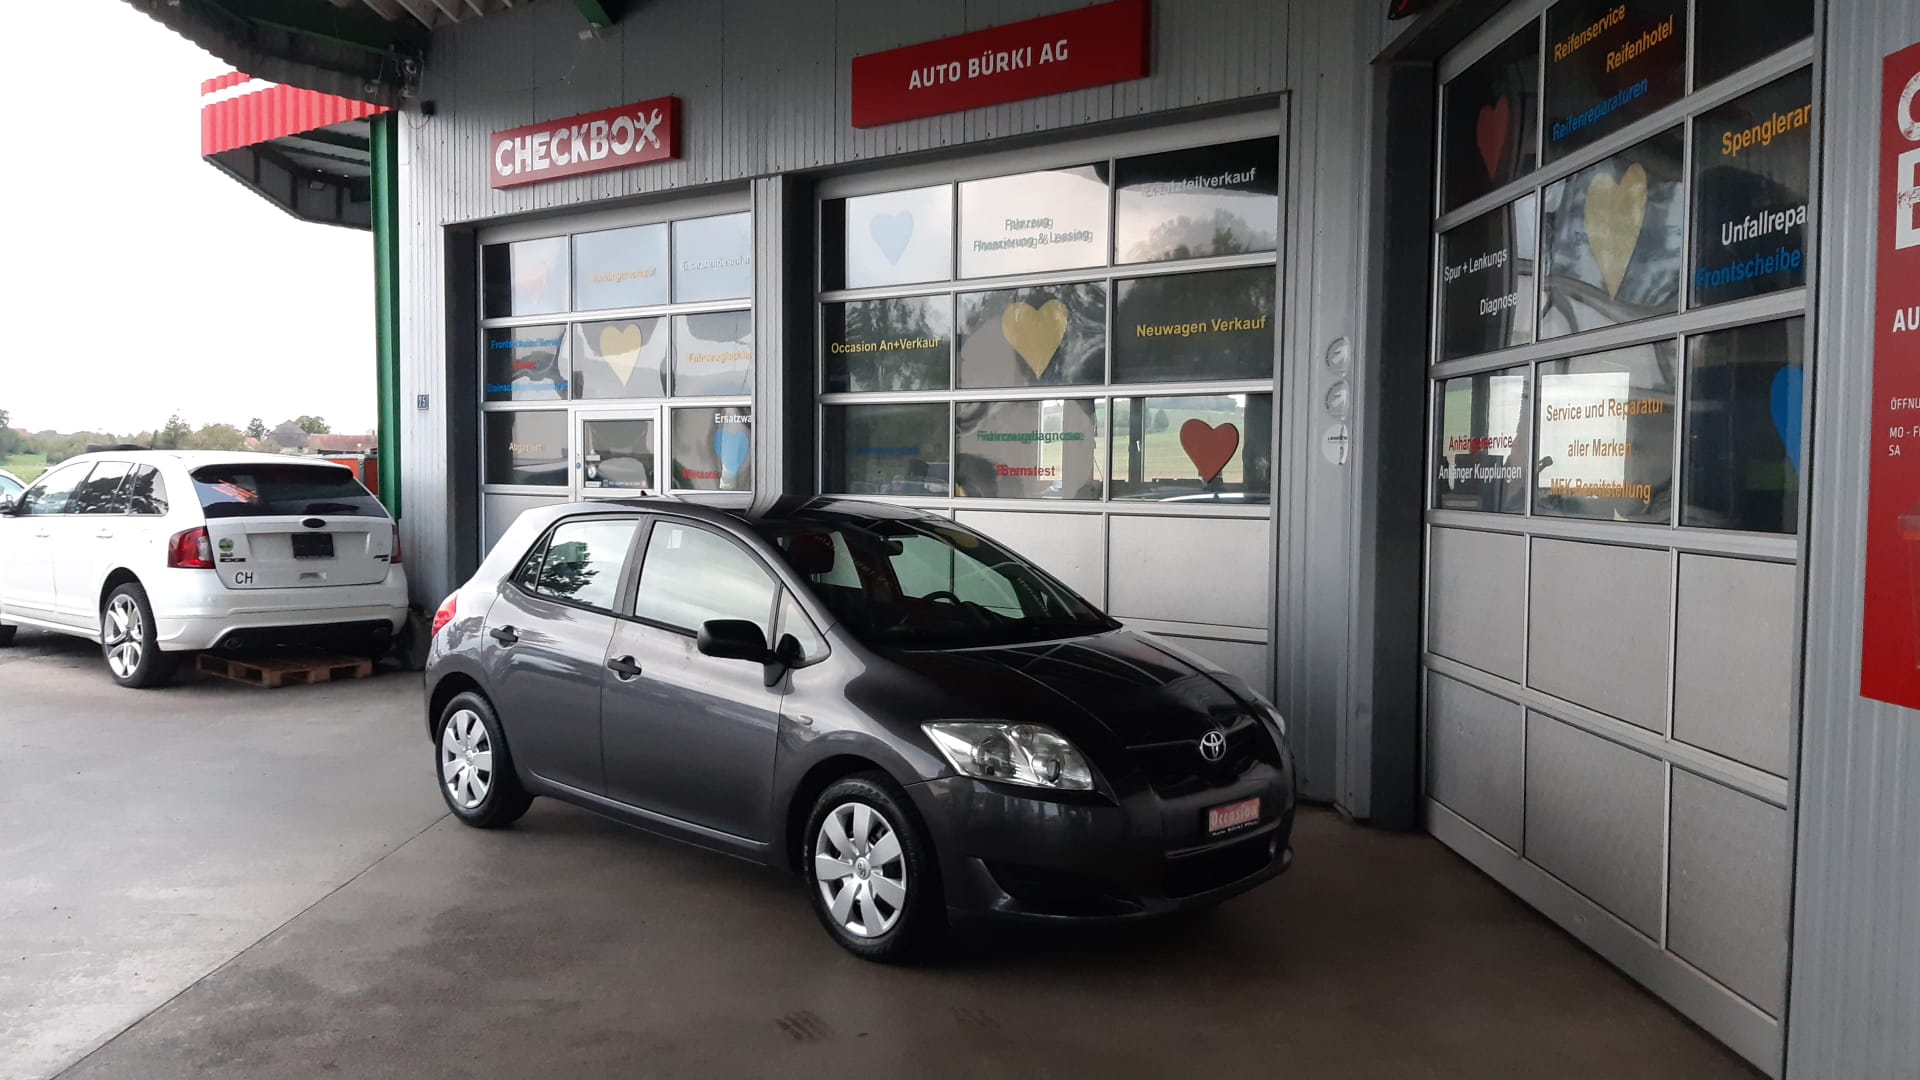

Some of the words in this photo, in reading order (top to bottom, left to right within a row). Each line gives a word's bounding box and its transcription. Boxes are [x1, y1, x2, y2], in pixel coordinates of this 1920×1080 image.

[1554, 4, 1626, 62] Reifenservice
[1606, 14, 1673, 72] Reifenhotel
[908, 62, 961, 90] AUTO
[968, 46, 1032, 78] BÜRKI
[1039, 39, 1069, 65] AG
[1552, 78, 1649, 142] Reifenreparaturen
[495, 108, 662, 176] CHECKBOX
[1721, 103, 1812, 157] Spenglerar
[1721, 204, 1809, 245] Unfallrepa
[1444, 264, 1461, 284] Spur
[1463, 262, 1468, 273] +
[1469, 248, 1508, 273] Lenkungs
[1696, 246, 1802, 291] Frontscheibe
[1480, 292, 1518, 316] Diagnose
[1136, 322, 1207, 337] Neuwagen
[1211, 315, 1266, 331] Verkauf
[1893, 306, 1920, 332] AU
[831, 341, 877, 354] Occasion
[880, 336, 940, 351] An+Verkauf
[1546, 403, 1582, 421] Service
[1585, 400, 1605, 418] und
[1608, 397, 1665, 421] Reparatur
[1890, 427, 1904, 438] MO
[1913, 426, 1920, 438] F
[1567, 439, 1590, 457] aller
[1592, 438, 1633, 457] Marken
[1888, 444, 1901, 456] SA
[1438, 464, 1473, 483] Anhänger
[1474, 463, 1522, 483] Kupplungen
[235, 572, 254, 584] CH
